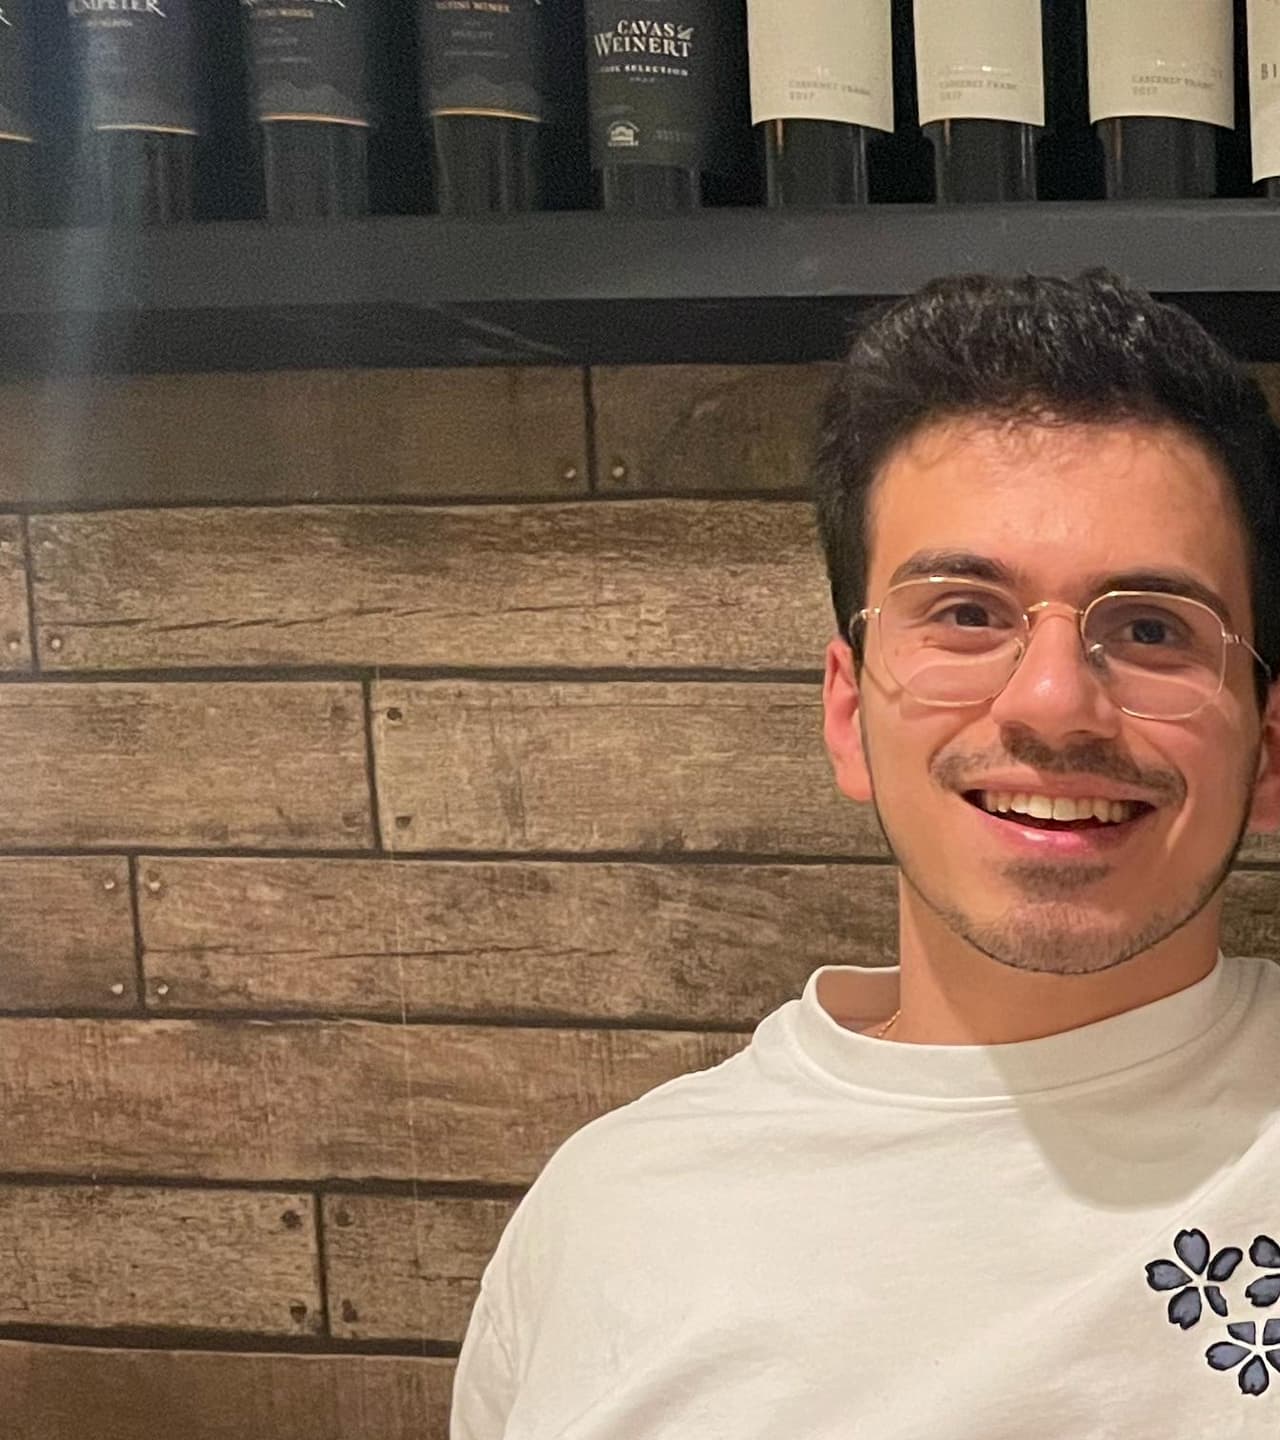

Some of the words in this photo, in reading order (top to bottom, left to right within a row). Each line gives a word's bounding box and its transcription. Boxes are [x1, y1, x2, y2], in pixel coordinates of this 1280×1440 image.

[617, 19, 675, 37] CAVAS
[593, 30, 693, 58] WEINERT
[624, 63, 690, 77] SELECTION
